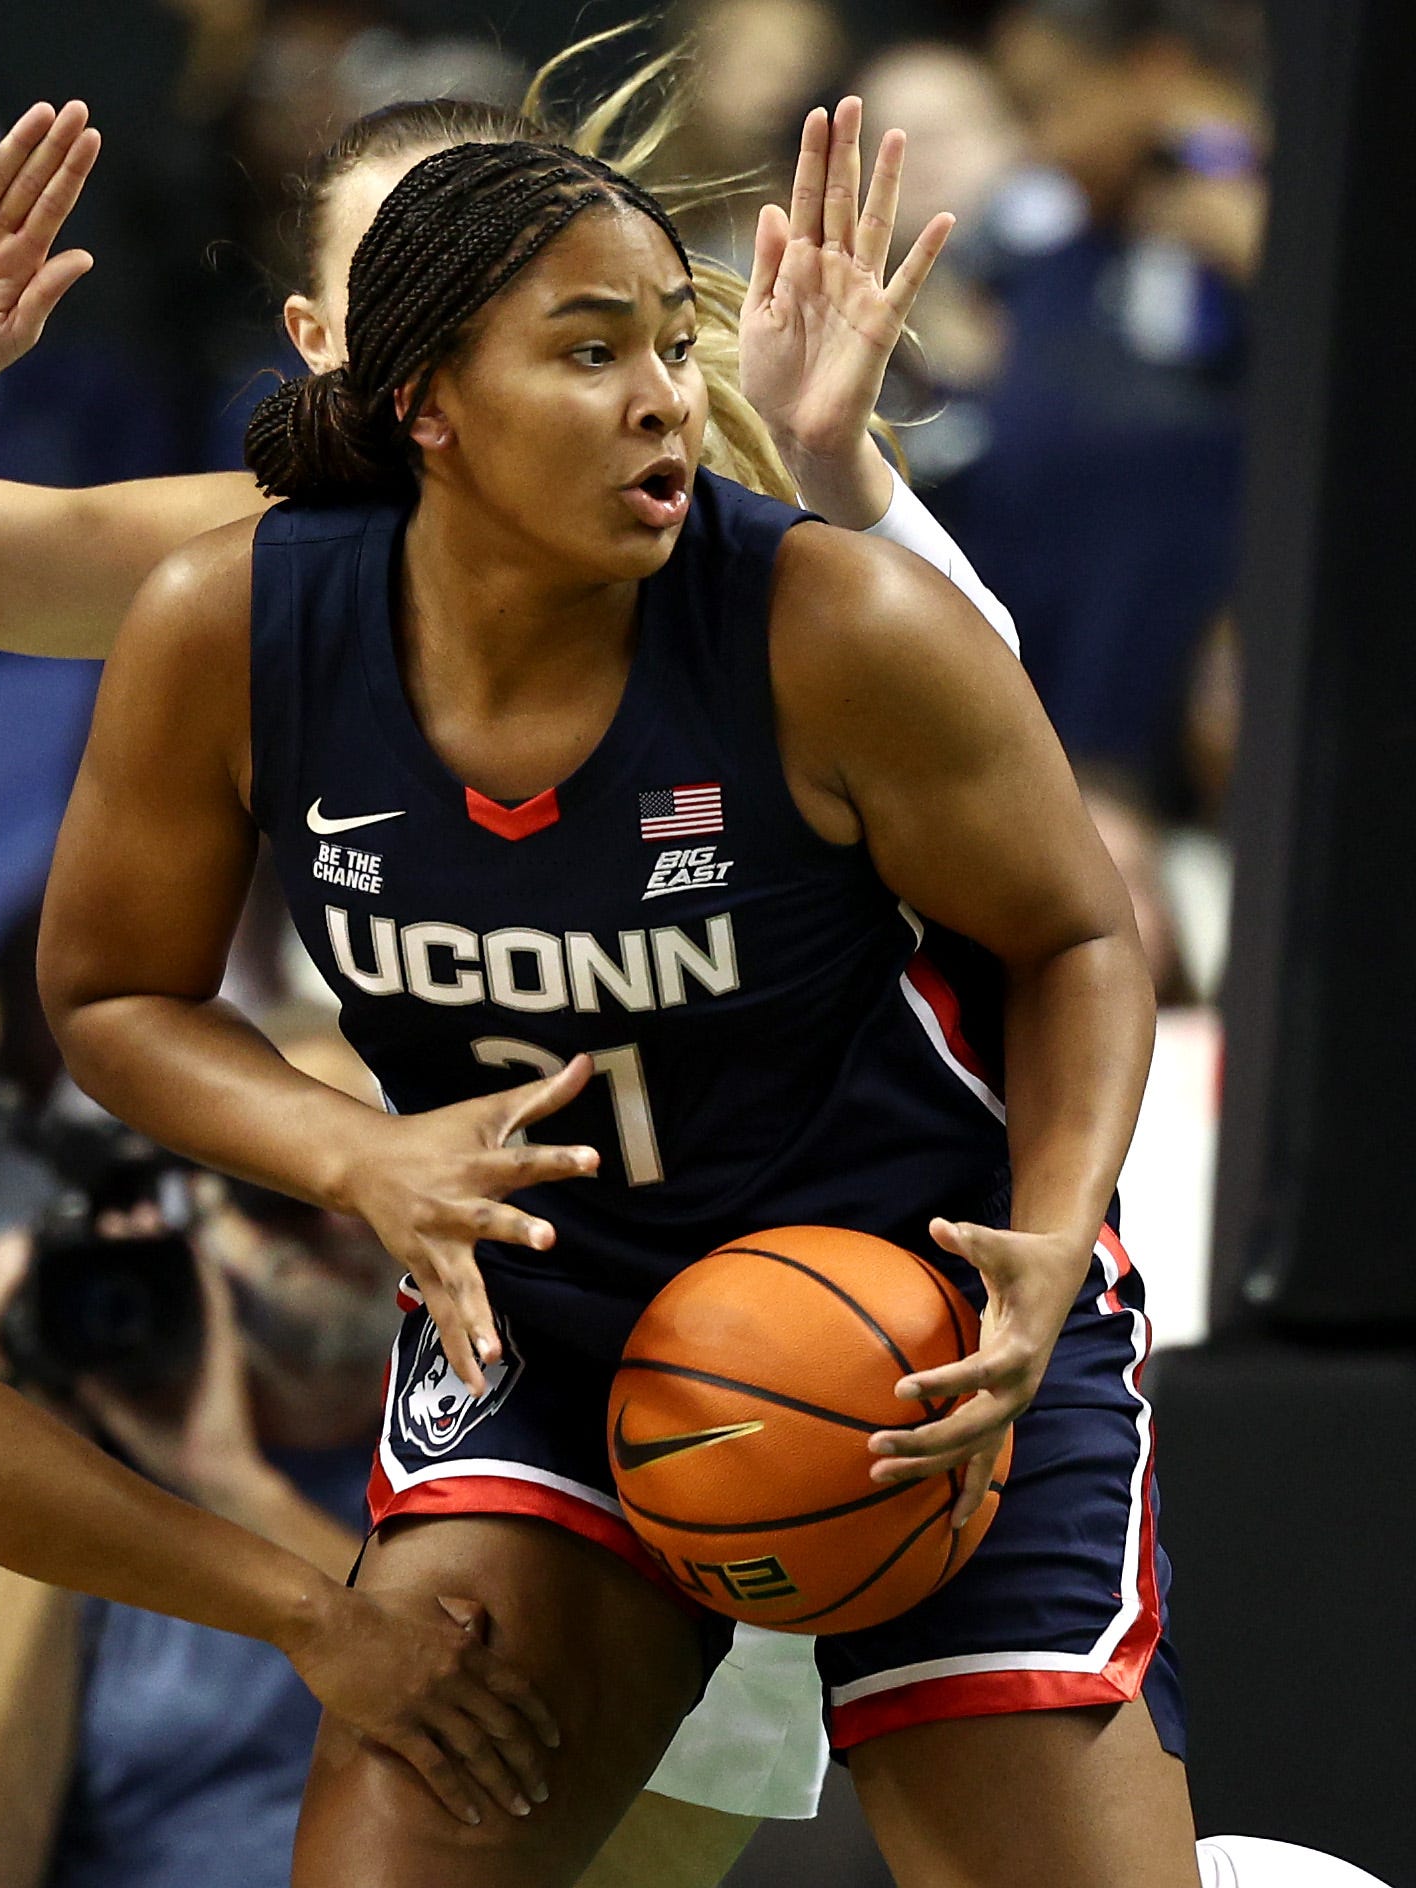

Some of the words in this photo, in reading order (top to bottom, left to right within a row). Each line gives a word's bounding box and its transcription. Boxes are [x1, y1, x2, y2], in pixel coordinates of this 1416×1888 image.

[317, 844, 342, 867] BE
[346, 850, 382, 875] THE
[654, 845, 718, 871] BIG
[312, 861, 384, 894] CHANGE
[646, 860, 735, 889] EAST
[324, 904, 741, 1013] UCONN
